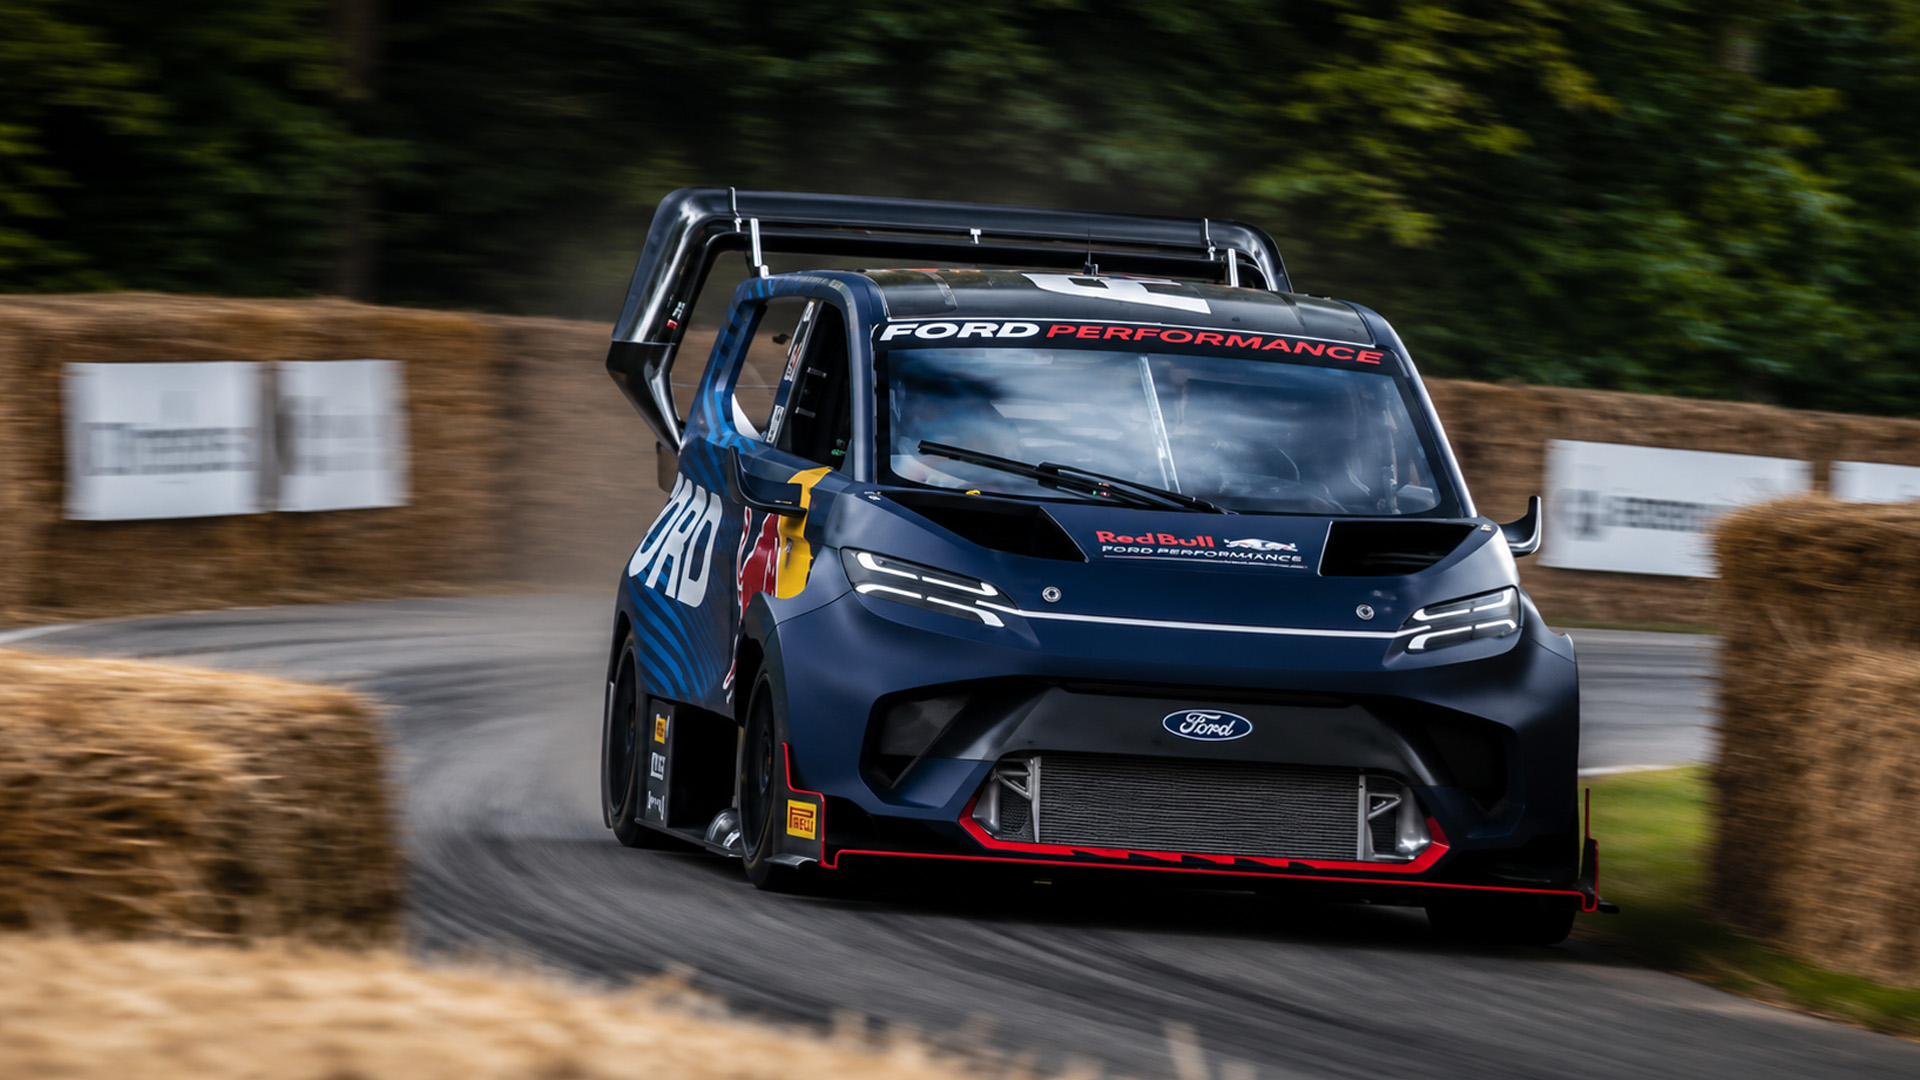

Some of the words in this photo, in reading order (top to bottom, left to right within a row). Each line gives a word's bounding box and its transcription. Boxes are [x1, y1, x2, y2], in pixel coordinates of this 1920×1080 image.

[879, 322, 1040, 341] FORD
[1046, 324, 1384, 364] PERFORMANCE
[628, 471, 723, 608] ORD
[1096, 530, 1155, 545] Red
[1157, 533, 1215, 548] Bull
[1102, 545, 1153, 554] FORD
[1157, 548, 1302, 562] PERFORMANCE
[1179, 712, 1236, 736] Ford
